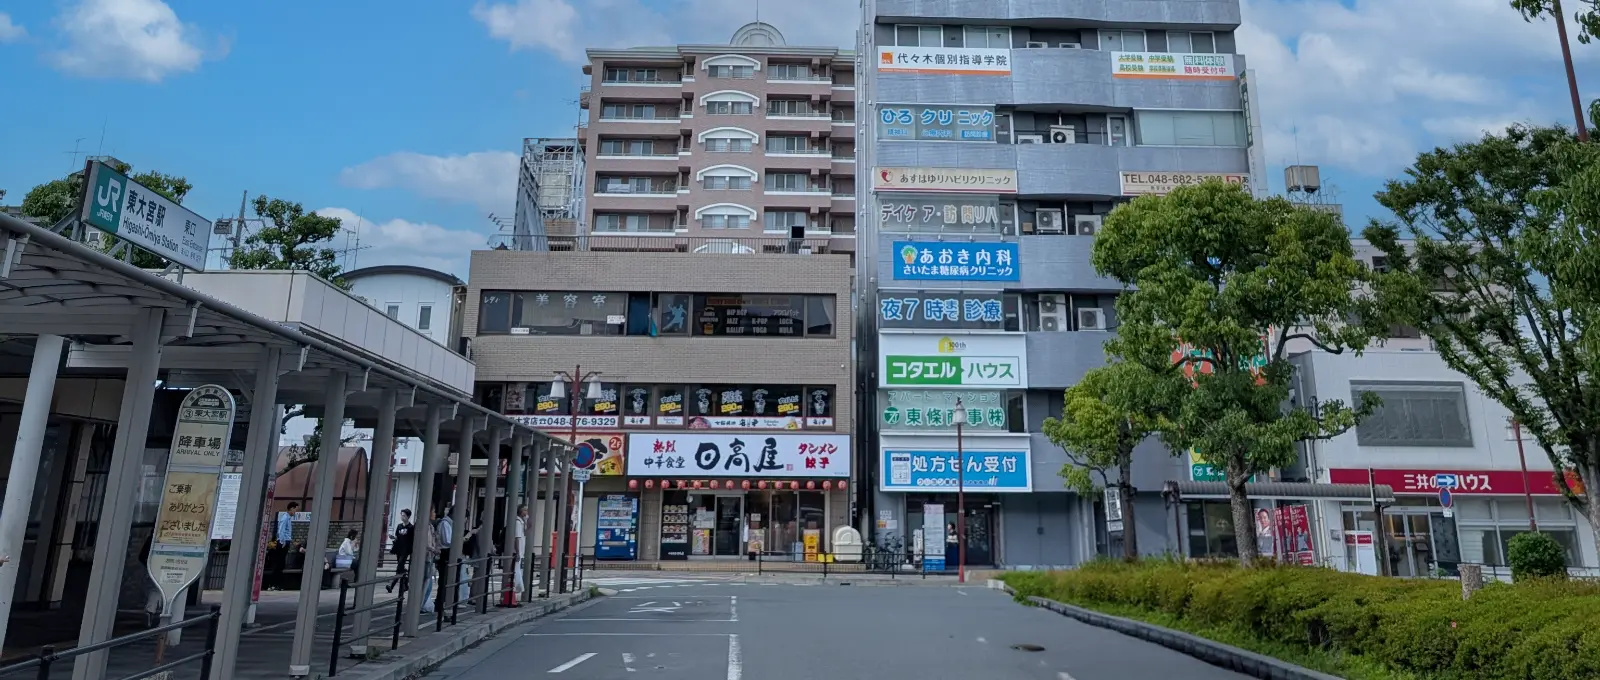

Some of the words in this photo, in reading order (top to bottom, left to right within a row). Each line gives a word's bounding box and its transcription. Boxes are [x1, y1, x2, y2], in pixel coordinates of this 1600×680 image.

[897, 52, 1008, 66] 代々木個別指導学院
[1184, 66, 1227, 74] 随時受付中
[98, 178, 122, 213] JR
[127, 189, 166, 228] 東大宮駅
[183, 219, 197, 237] 東口
[161, 234, 179, 252] Station
[920, 248, 1012, 265] あおき内科
[903, 265, 1013, 276] さいたま糖尿病クリニック
[536, 293, 607, 309] 美容室
[726, 317, 738, 325] JAZZ
[752, 317, 768, 325] K-POP
[779, 317, 793, 325] LOCK
[892, 361, 956, 379] コタエル
[968, 362, 1014, 379] ハウス
[178, 435, 222, 450] 降車場
[610, 438, 622, 448] 2F
[798, 443, 839, 455] タンメン
[644, 454, 686, 469] 中華食堂
[694, 437, 785, 473] 日高屋
[805, 456, 830, 469] 餃子
[912, 456, 1018, 473] 処方せん受付
[168, 483, 192, 495] ご乗車
[168, 502, 205, 514] ありがとう
[161, 520, 208, 532] ございました
